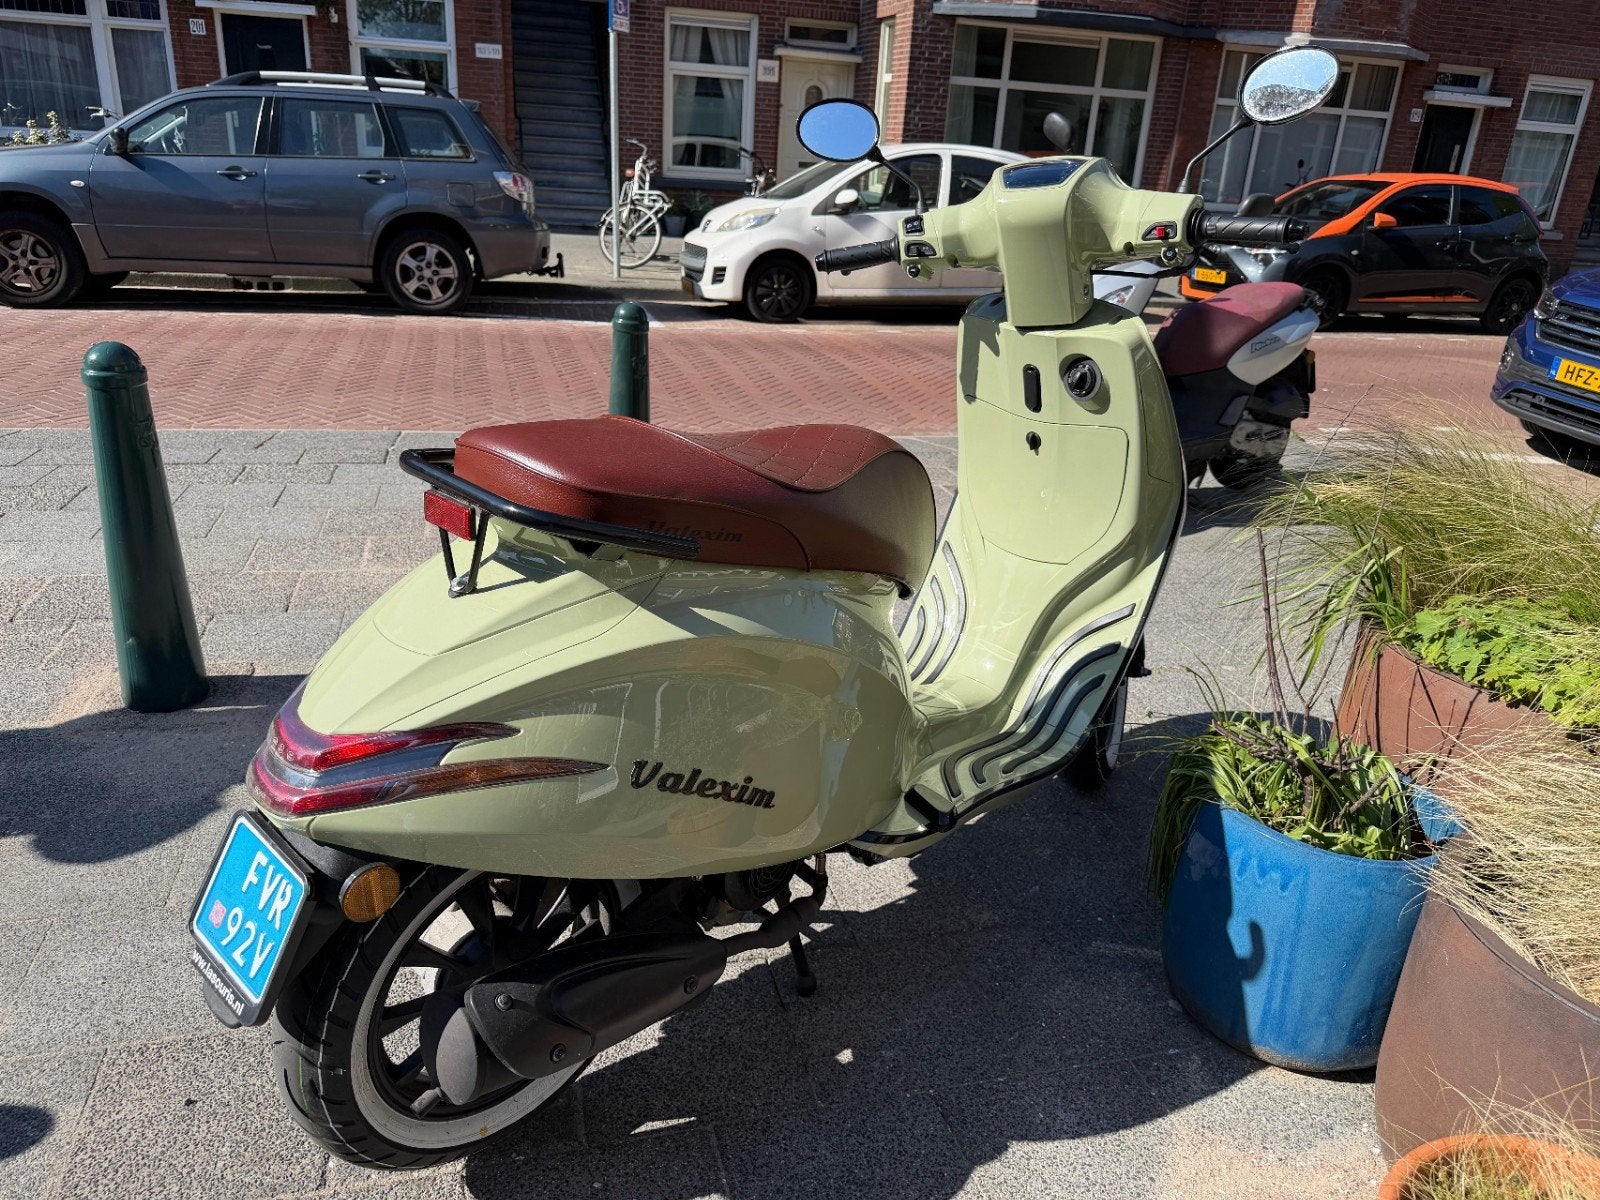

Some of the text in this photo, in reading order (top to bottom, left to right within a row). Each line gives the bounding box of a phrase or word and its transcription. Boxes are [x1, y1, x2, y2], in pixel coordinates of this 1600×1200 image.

[191, 20, 205, 34] 201
[1564, 364, 1600, 388] HFZ-
[630, 758, 776, 809] Valexim
[241, 851, 293, 930] FVR
[220, 907, 275, 979] 92V
